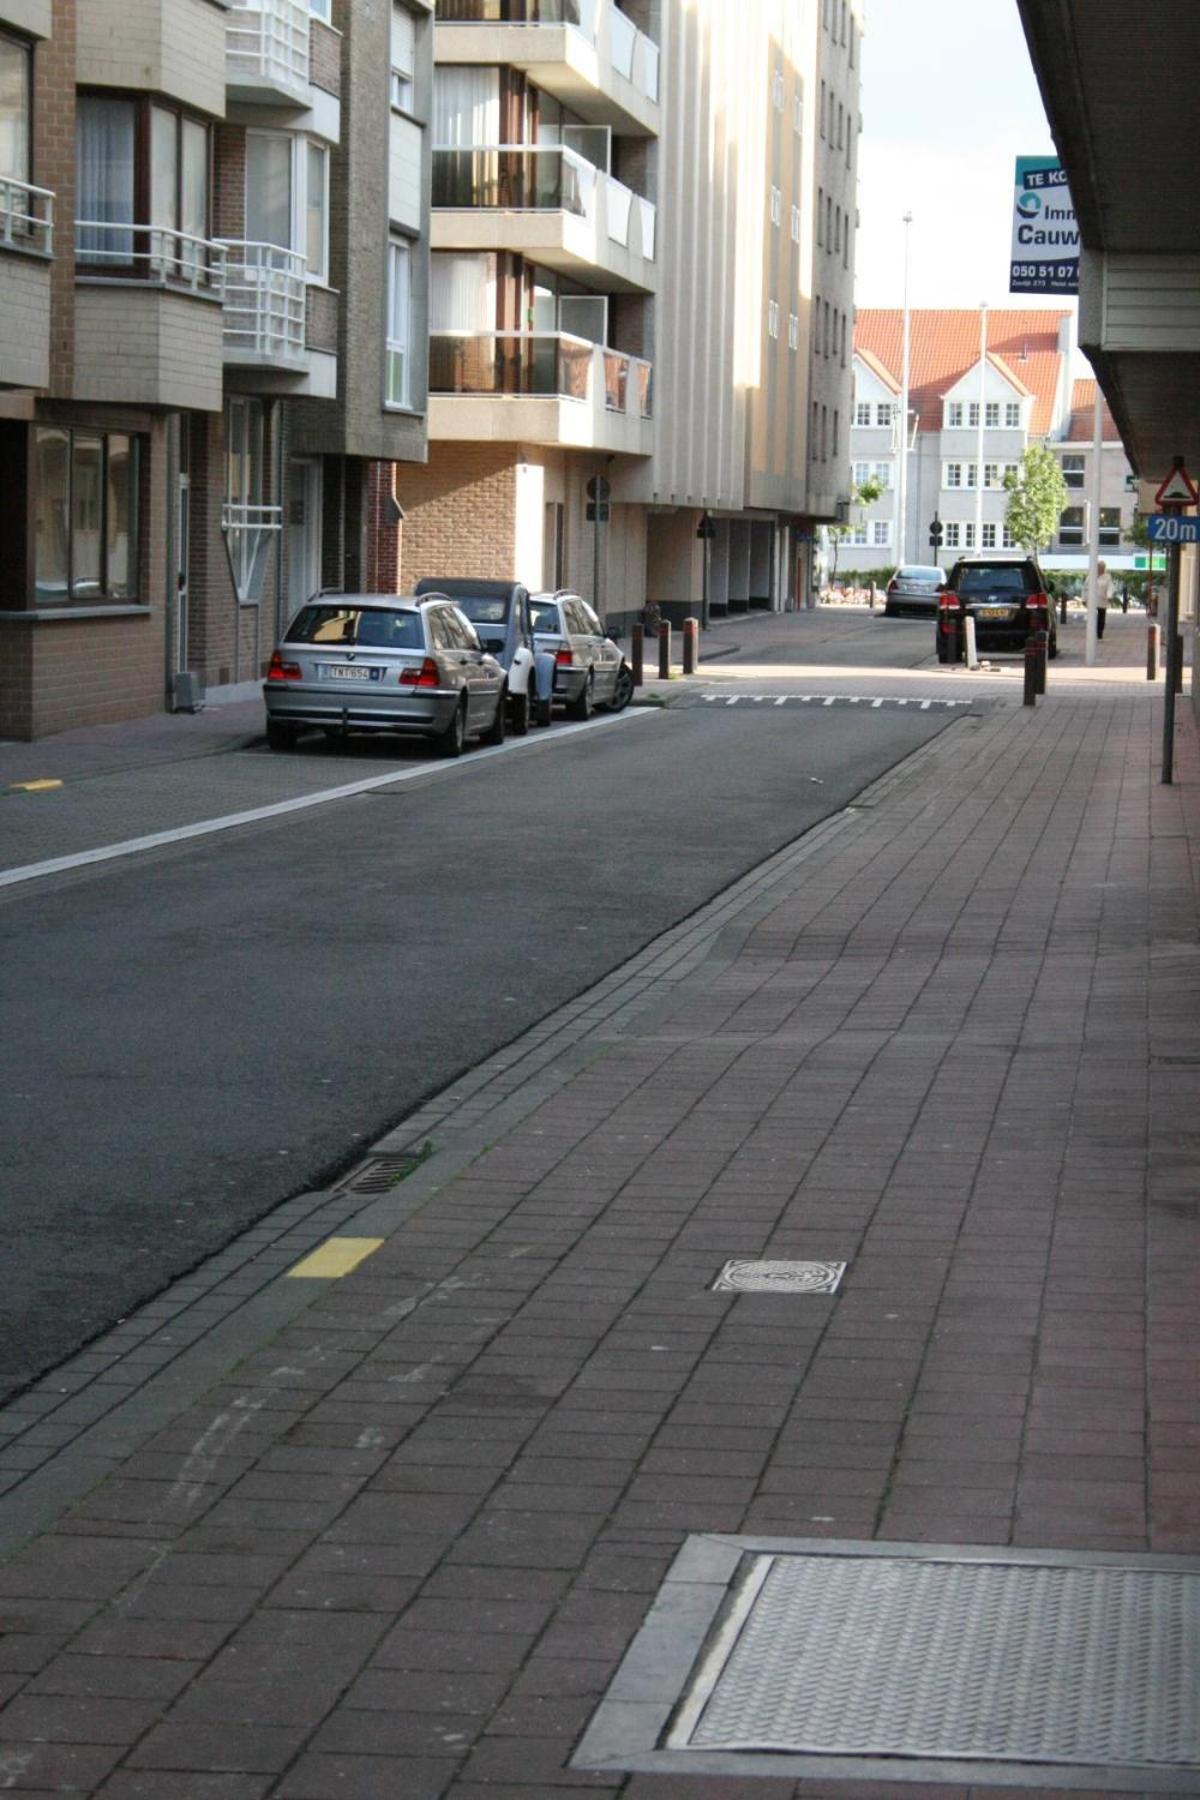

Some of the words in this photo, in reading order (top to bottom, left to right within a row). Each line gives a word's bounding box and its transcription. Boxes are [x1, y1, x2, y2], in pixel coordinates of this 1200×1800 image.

[1026, 173, 1044, 186] TE
[1012, 265, 1036, 277] 050
[1039, 266, 1054, 277] 51
[1058, 266, 1074, 277] 07
[1154, 518, 1197, 540] 20m
